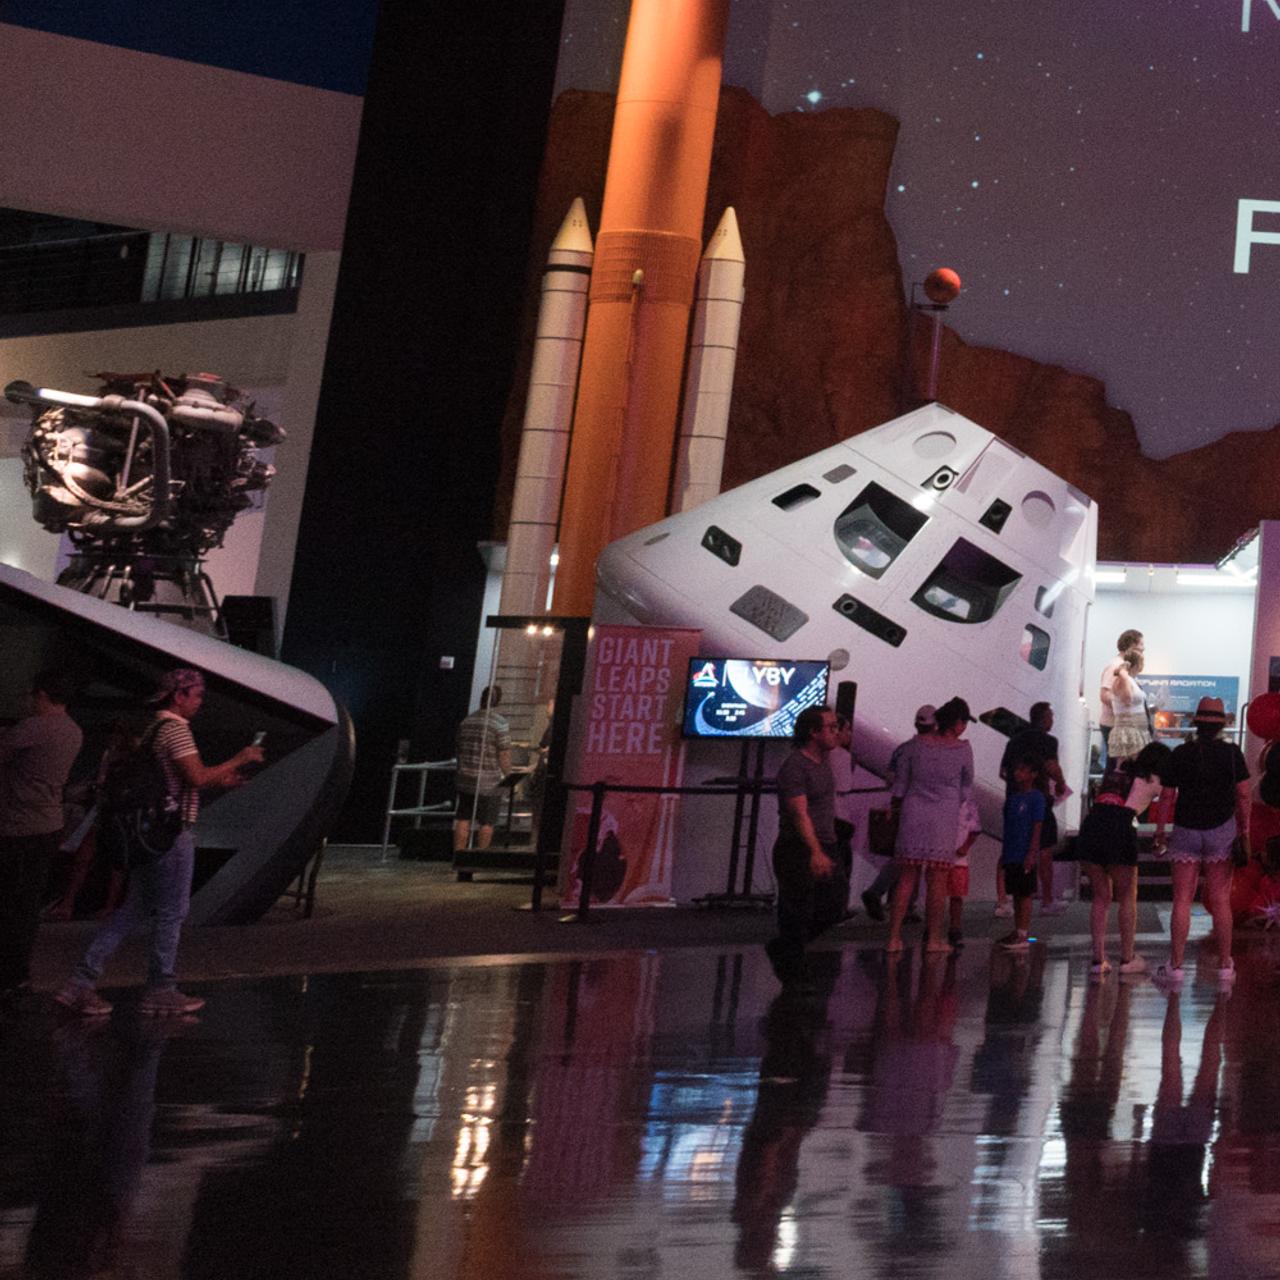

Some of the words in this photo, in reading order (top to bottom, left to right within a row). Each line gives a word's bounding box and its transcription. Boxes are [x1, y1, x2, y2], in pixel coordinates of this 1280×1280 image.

[600, 636, 675, 666] GIANT
[594, 666, 671, 693] LEAPS
[592, 694, 669, 721] START
[587, 721, 663, 755] HERE
